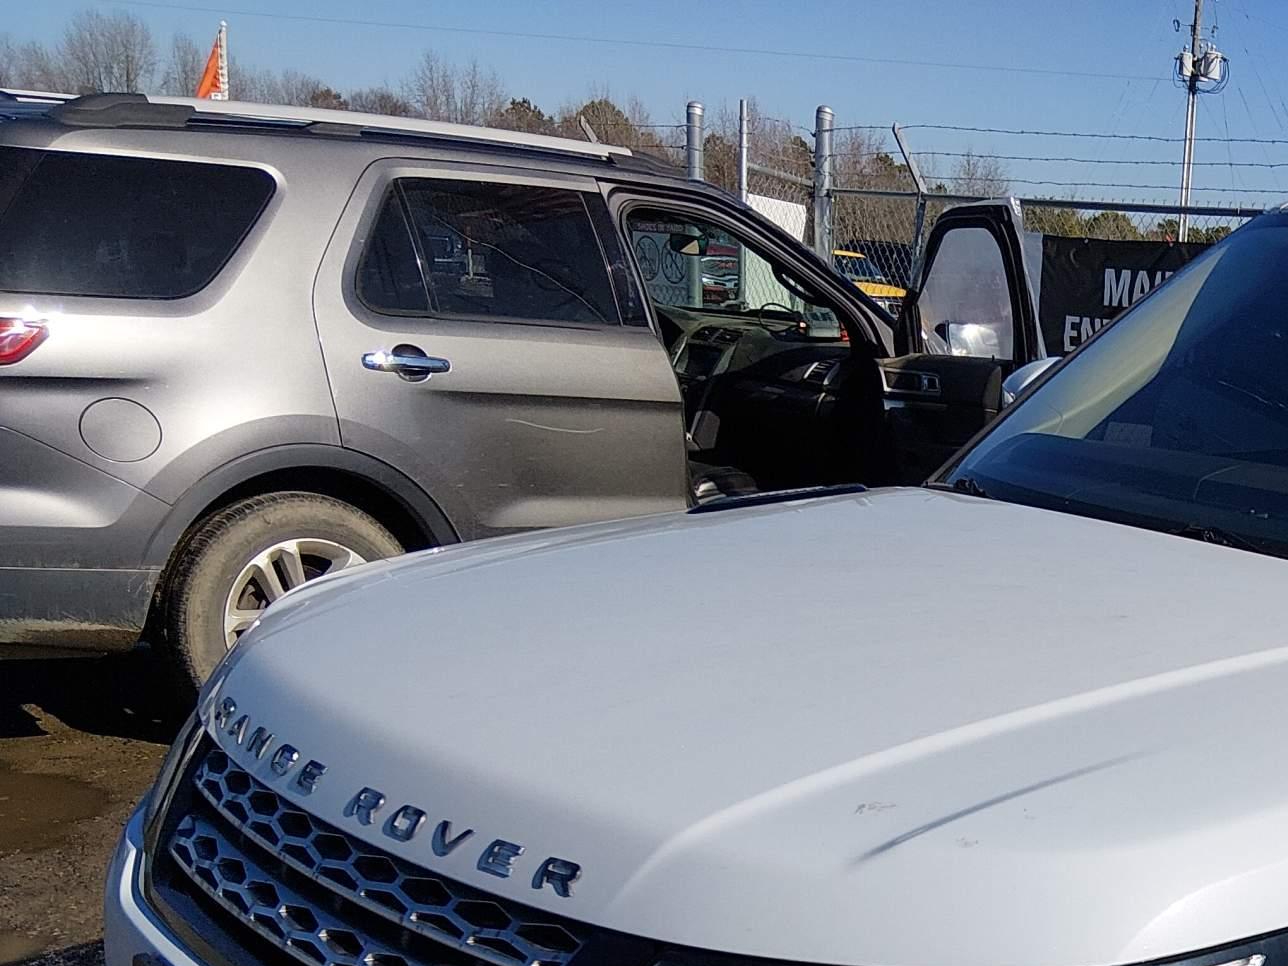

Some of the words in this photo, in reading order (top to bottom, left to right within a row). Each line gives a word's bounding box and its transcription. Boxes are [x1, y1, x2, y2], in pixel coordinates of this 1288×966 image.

[1103, 268, 1174, 308] MA
[1063, 315, 1112, 352] EN
[215, 696, 328, 796] RANGE
[343, 786, 583, 898] ROVER
